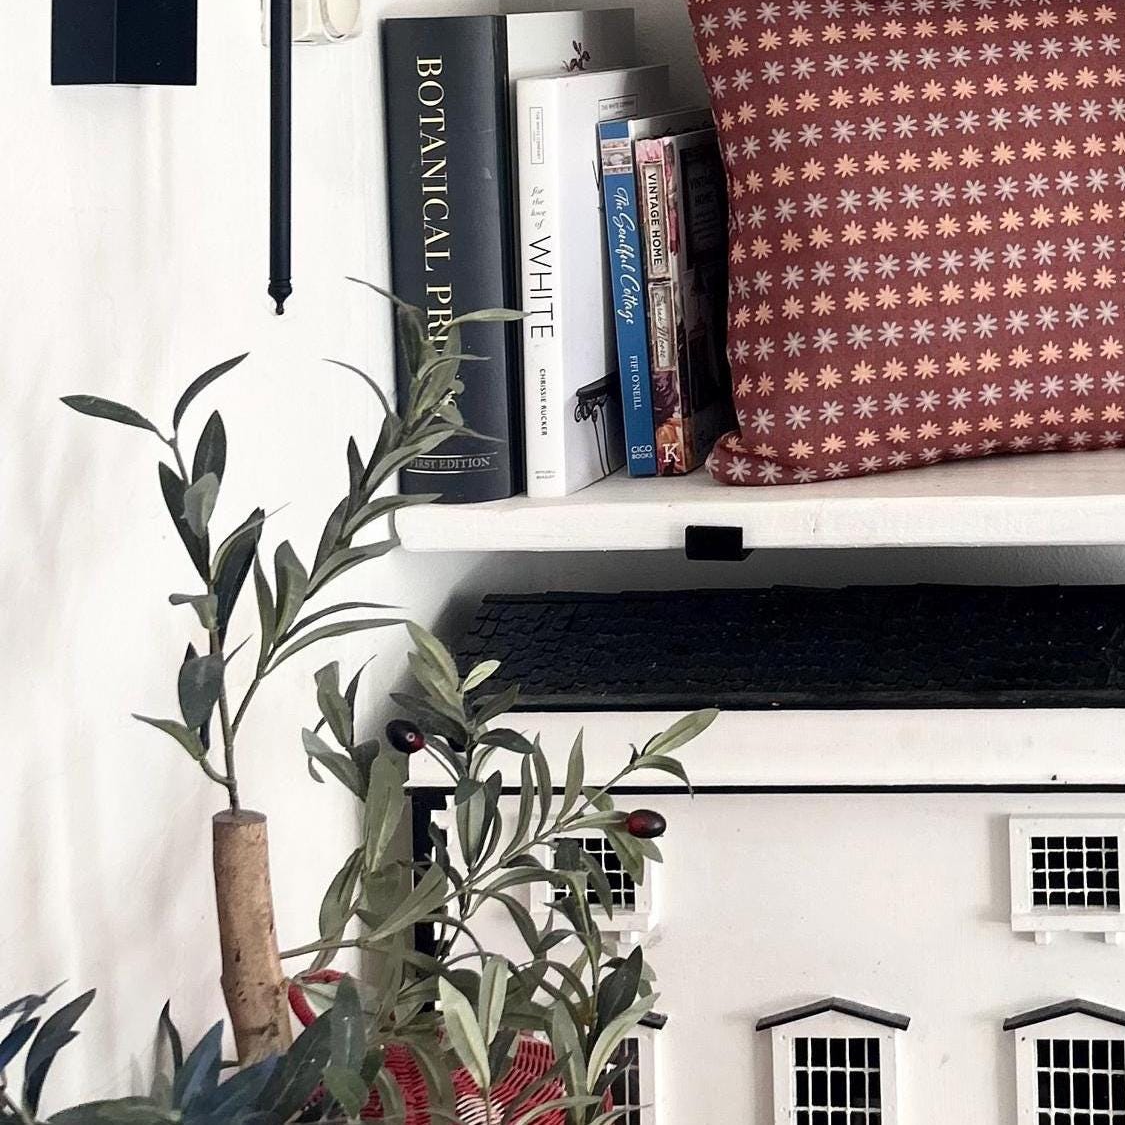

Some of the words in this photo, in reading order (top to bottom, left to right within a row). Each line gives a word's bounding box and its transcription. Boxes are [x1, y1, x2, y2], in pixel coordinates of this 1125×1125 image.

[417, 55, 450, 271] BOTANICAL
[531, 187, 544, 196] for
[614, 187, 629, 210] The
[648, 173, 660, 226] VINTAGE
[534, 219, 544, 230] of
[613, 213, 635, 272] Soulful
[652, 230, 663, 266] HOME
[529, 235, 553, 338] WHITE
[617, 275, 641, 324] Cottage
[630, 355, 639, 372] FIFI
[632, 374, 642, 410] O'NEILL
[439, 457, 491, 469] EDITION
[632, 444, 652, 453] CICO
[662, 443, 680, 463] K
